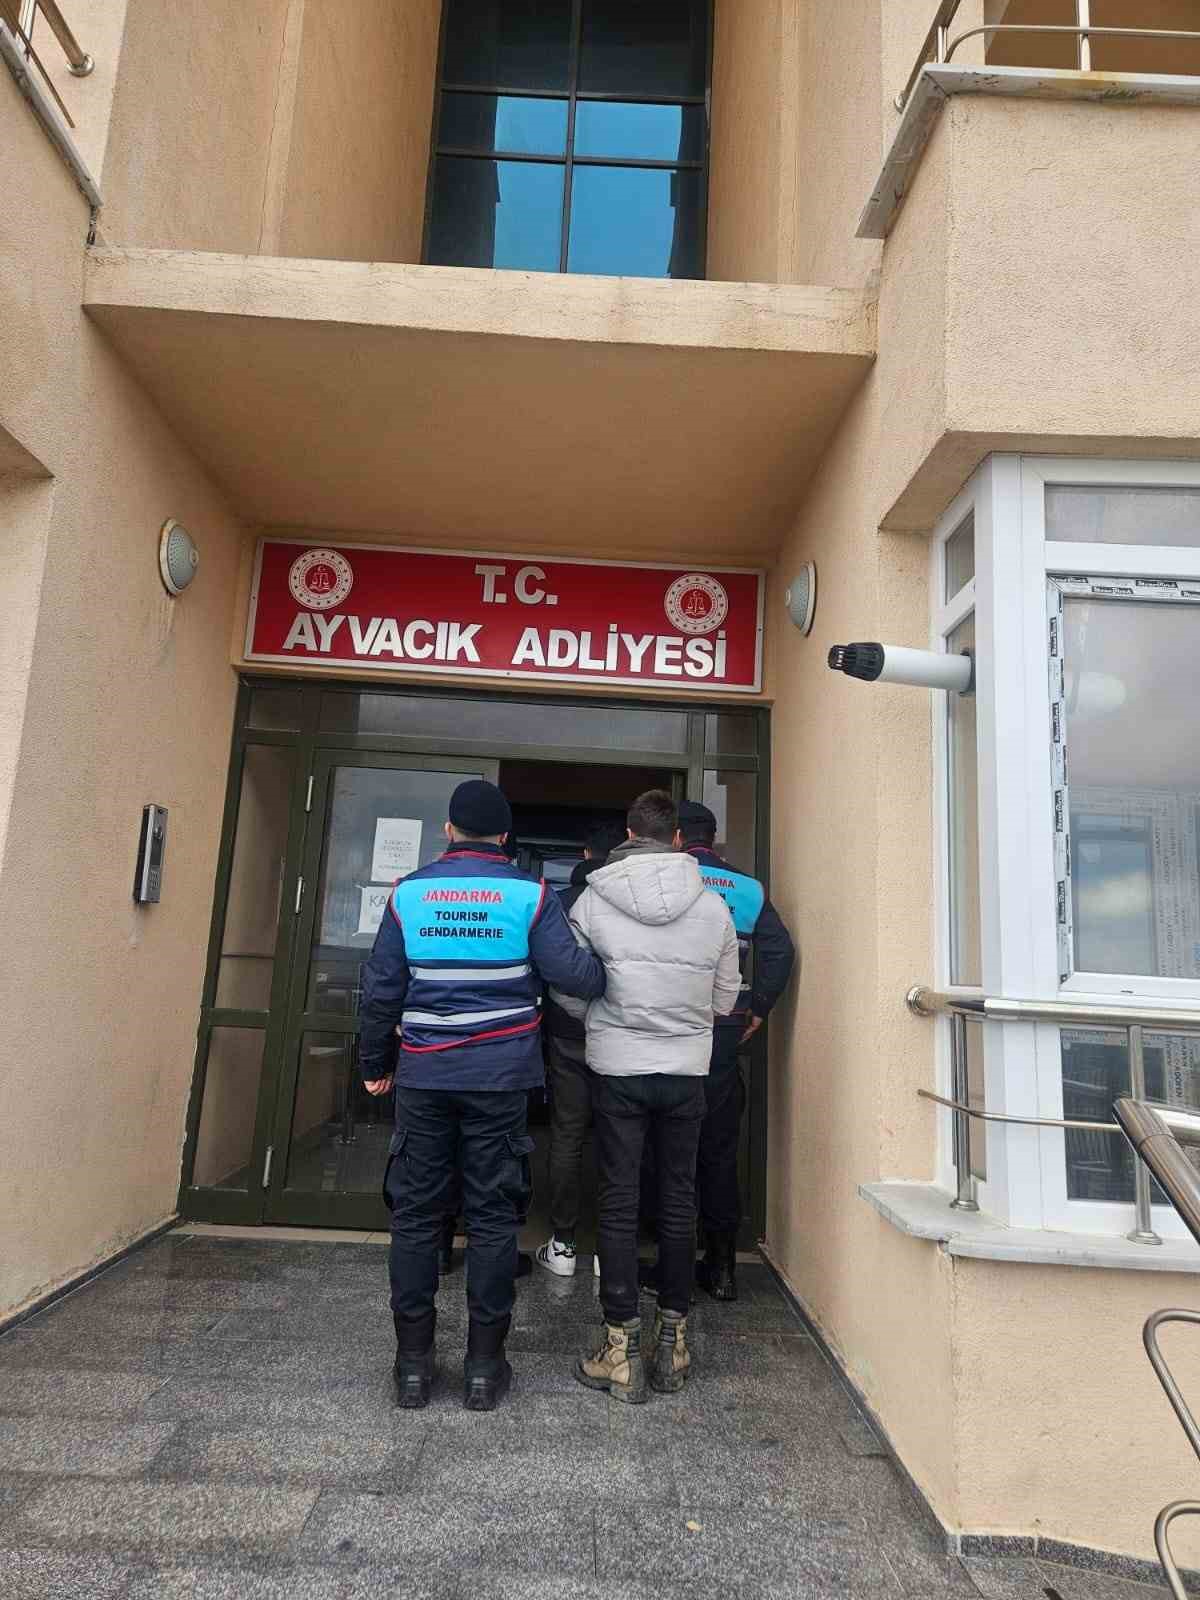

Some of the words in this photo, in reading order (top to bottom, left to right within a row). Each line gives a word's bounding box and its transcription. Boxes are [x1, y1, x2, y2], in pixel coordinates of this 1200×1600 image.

[475, 564, 558, 605] T.C.
[283, 612, 483, 662] AYVACIK
[511, 623, 727, 678] ADLİYESİ
[702, 877, 736, 888] ARMA
[423, 889, 503, 903] JANDARMA
[435, 911, 488, 922] TOURISM
[420, 927, 504, 938] GENDARMERIE
